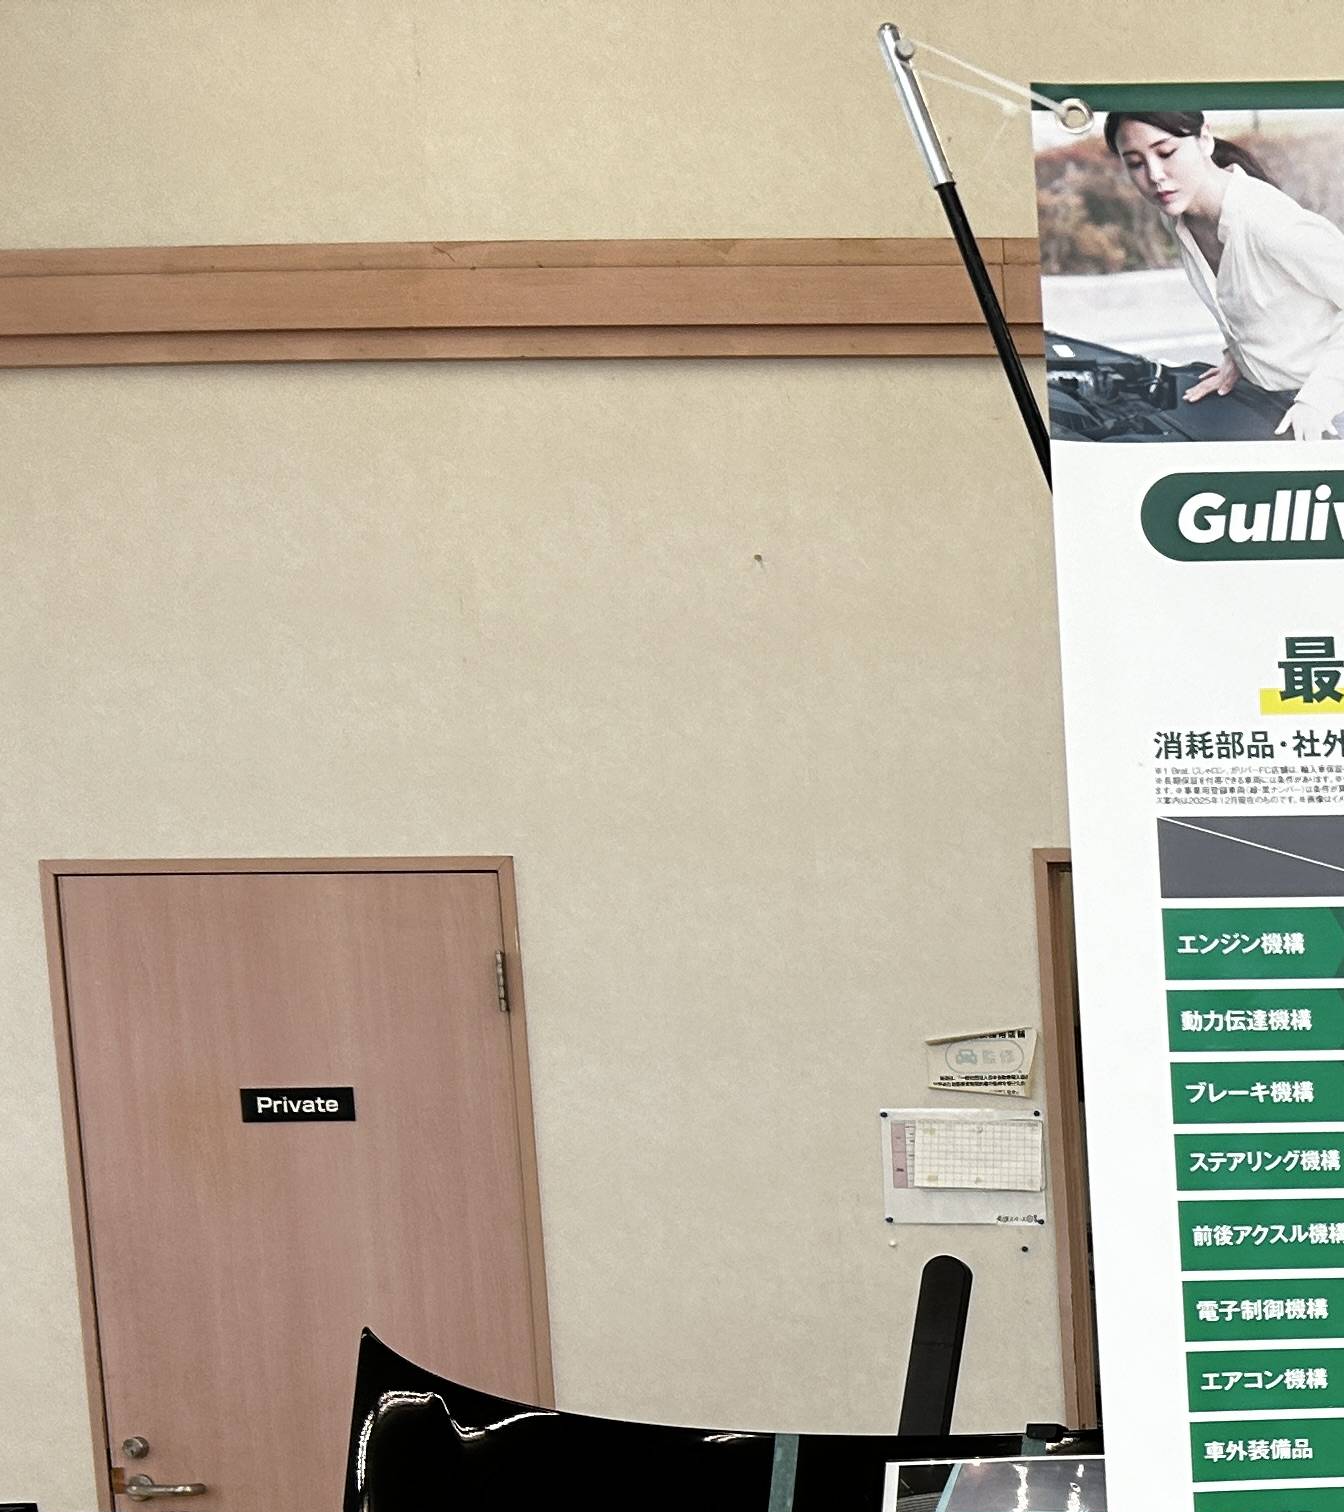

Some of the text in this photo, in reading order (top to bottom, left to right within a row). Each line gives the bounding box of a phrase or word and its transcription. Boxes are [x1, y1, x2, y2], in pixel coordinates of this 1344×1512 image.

[1178, 932, 1305, 955] エンジン機構
[1181, 1009, 1312, 1031] 動力伝達機構
[1185, 1081, 1314, 1103] ブレーキ機構
[256, 1096, 340, 1114] Private
[1189, 1150, 1340, 1172] ステアリング機構
[1197, 1299, 1328, 1322] 電子制御機構
[1201, 1368, 1328, 1390] エアコン機構
[1204, 1439, 1313, 1461] 車外装備品
